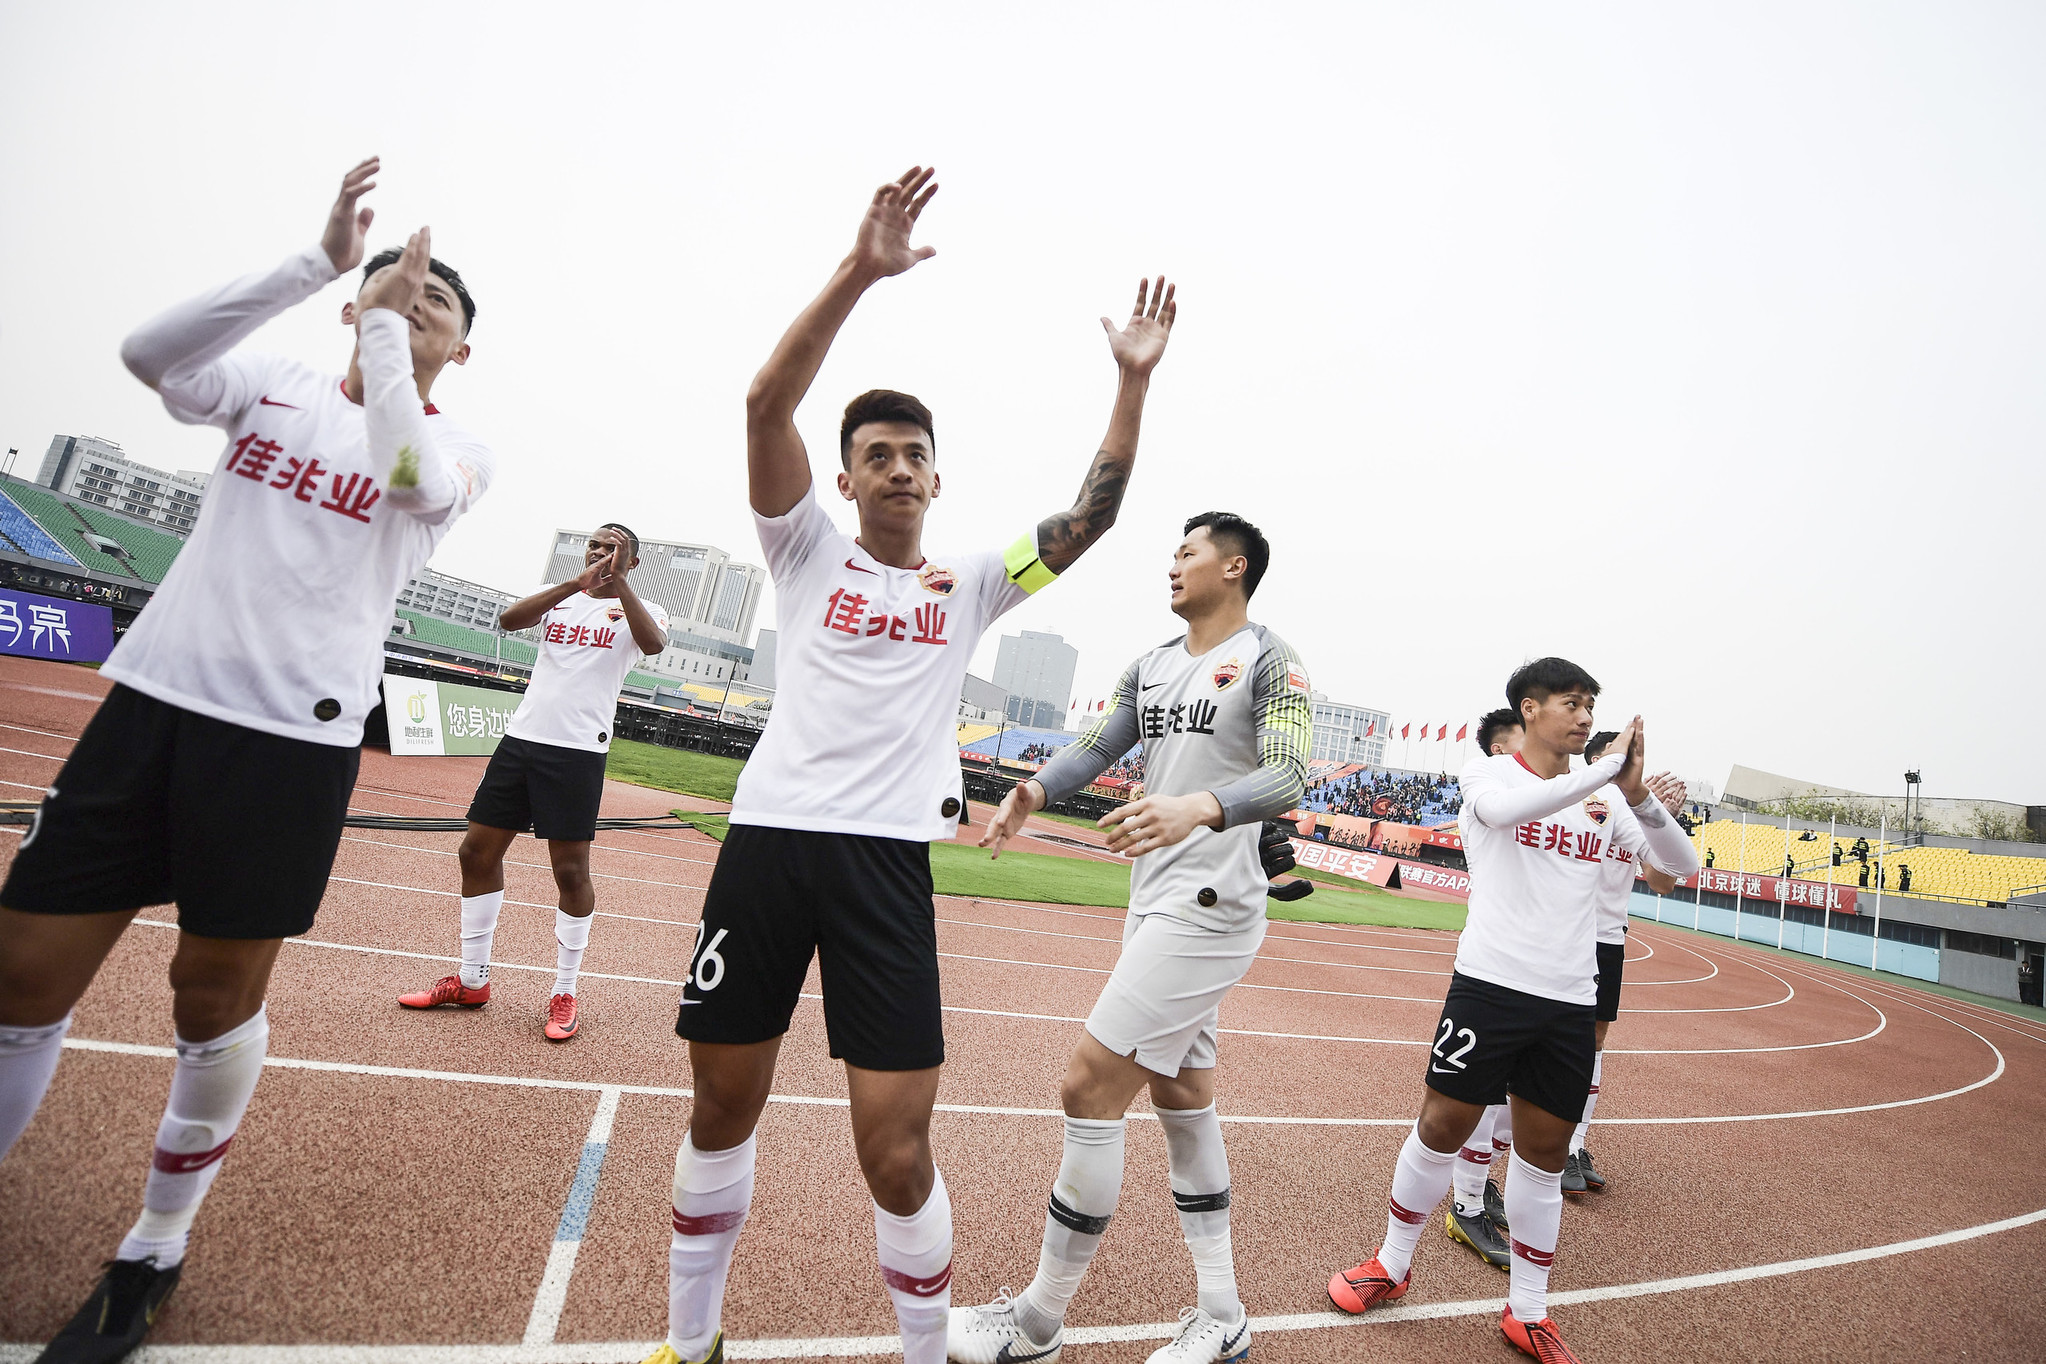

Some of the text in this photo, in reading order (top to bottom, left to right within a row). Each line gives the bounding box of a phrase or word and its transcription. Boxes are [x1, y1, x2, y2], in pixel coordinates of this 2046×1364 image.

[225, 431, 381, 524] 佳兆业
[545, 621, 616, 650] 佳兆业
[823, 587, 948, 646] 佳兆业
[1141, 698, 1218, 739] 佳兆业
[1699, 871, 1842, 909] 北京球迷 懂球懂礼
[1432, 1017, 1477, 1069] 22
